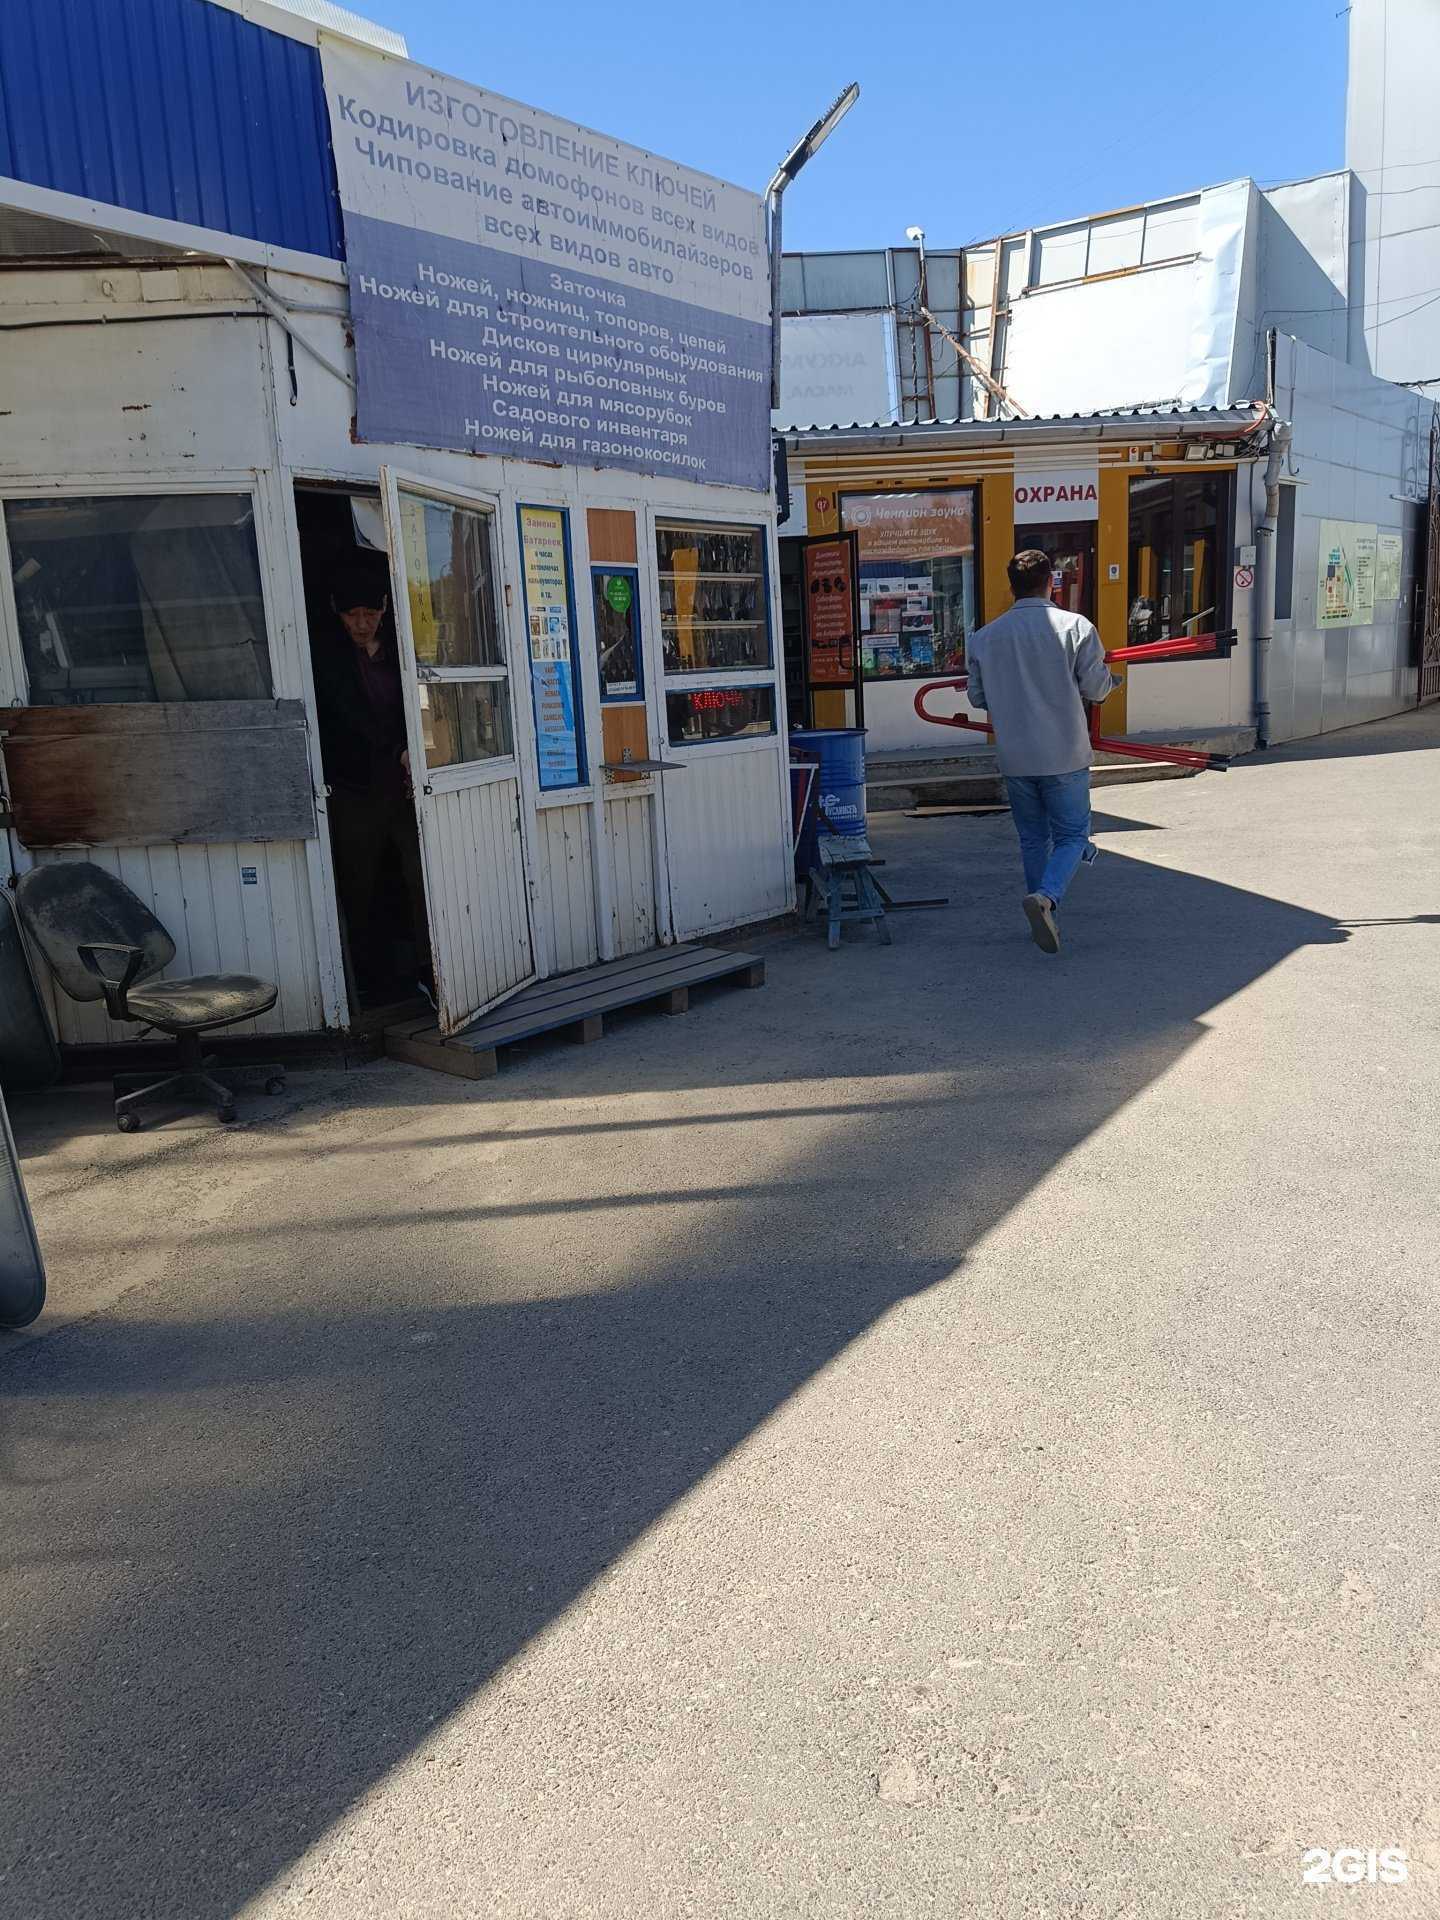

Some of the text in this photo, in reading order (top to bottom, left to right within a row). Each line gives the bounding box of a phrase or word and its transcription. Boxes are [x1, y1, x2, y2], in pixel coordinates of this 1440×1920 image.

[337, 94, 758, 256] Кодировка домофонов всех видов
[405, 81, 716, 213] ИЗГОТОВЛЕНИЕ КЛЮЧЕЙ
[354, 137, 754, 281] Чипование автоиммобилайзеров
[484, 215, 674, 284] всех видов авто
[417, 263, 727, 355] Ножей, ножниц, топоров, цепей
[549, 273, 626, 307] Заточка
[359, 275, 764, 384] Ножей для строительного оборудования
[482, 327, 688, 386] Дисков циркулярных
[429, 339, 727, 415] Ножей для рыболовных буров
[482, 374, 693, 428] Ножей для мясорубок
[464, 418, 707, 470] Ножей для газонокосилок
[491, 400, 688, 446] Садового инвентаря
[875, 508, 928, 519] Чемпион
[1014, 484, 1098, 504] ОХРАНА
[524, 535, 561, 546] Батареек
[526, 518, 557, 529] Замена
